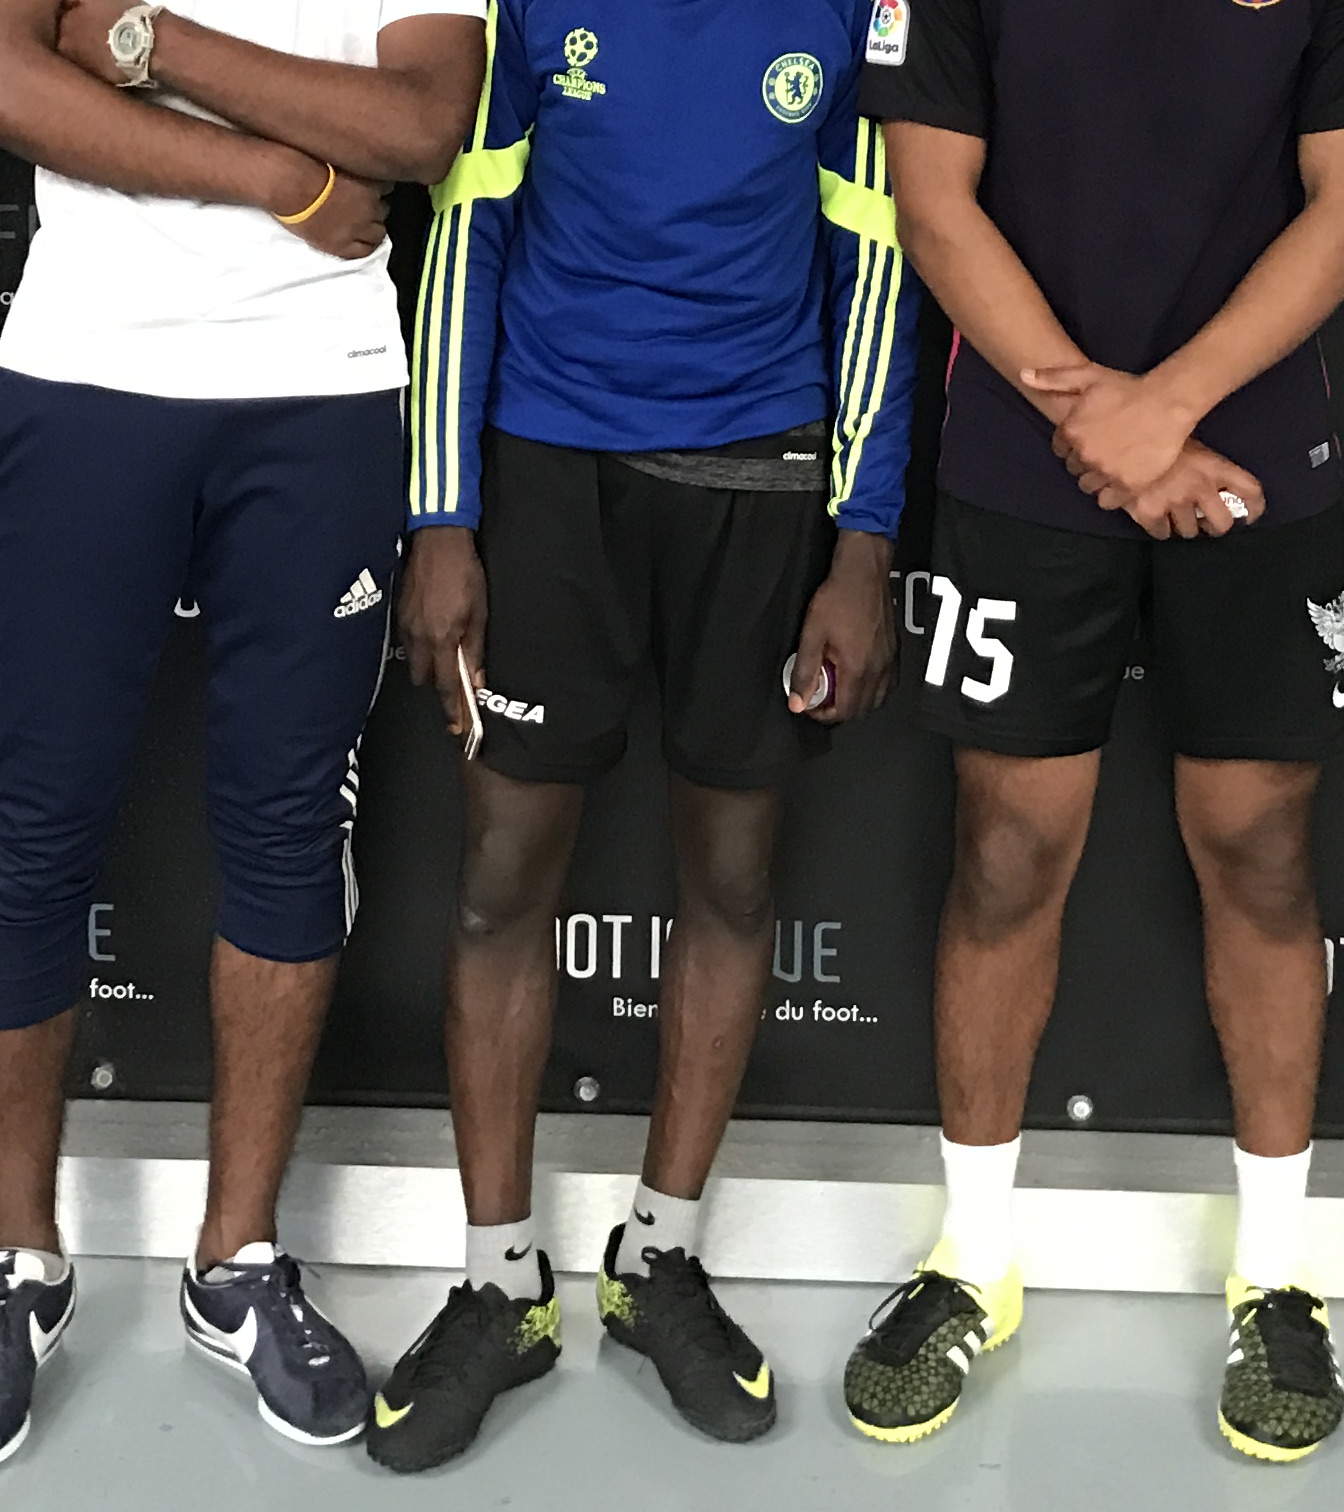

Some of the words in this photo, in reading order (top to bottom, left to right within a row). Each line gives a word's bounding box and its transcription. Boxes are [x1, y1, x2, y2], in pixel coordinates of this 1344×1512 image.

[347, 345, 387, 359] climacool
[333, 589, 384, 619] adidas
[924, 575, 1017, 703] 15
[89, 978, 155, 1001] foot...
[775, 1000, 805, 1022] du
[812, 1000, 879, 1024] foot...
